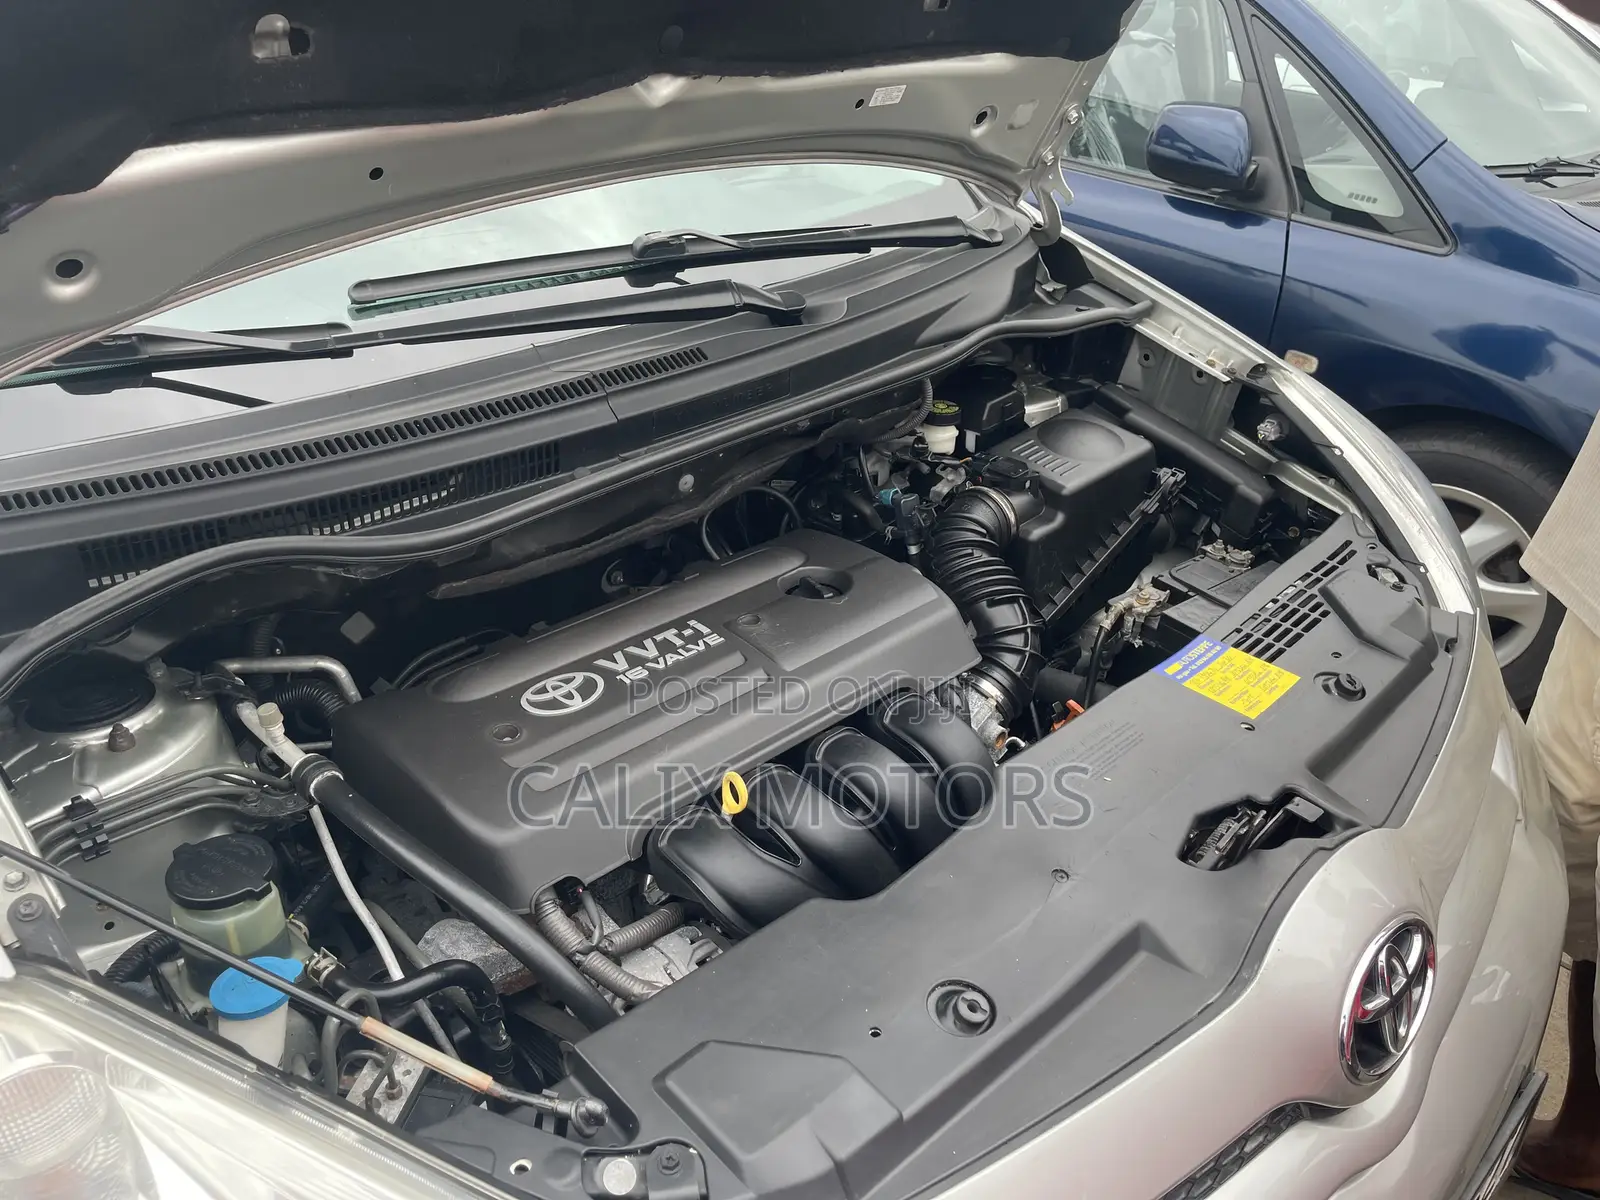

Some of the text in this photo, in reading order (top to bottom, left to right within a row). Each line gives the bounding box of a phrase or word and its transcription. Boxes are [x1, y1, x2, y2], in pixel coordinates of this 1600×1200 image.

[593, 620, 711, 672] VVT-i
[616, 633, 725, 684] 16 VALVE
